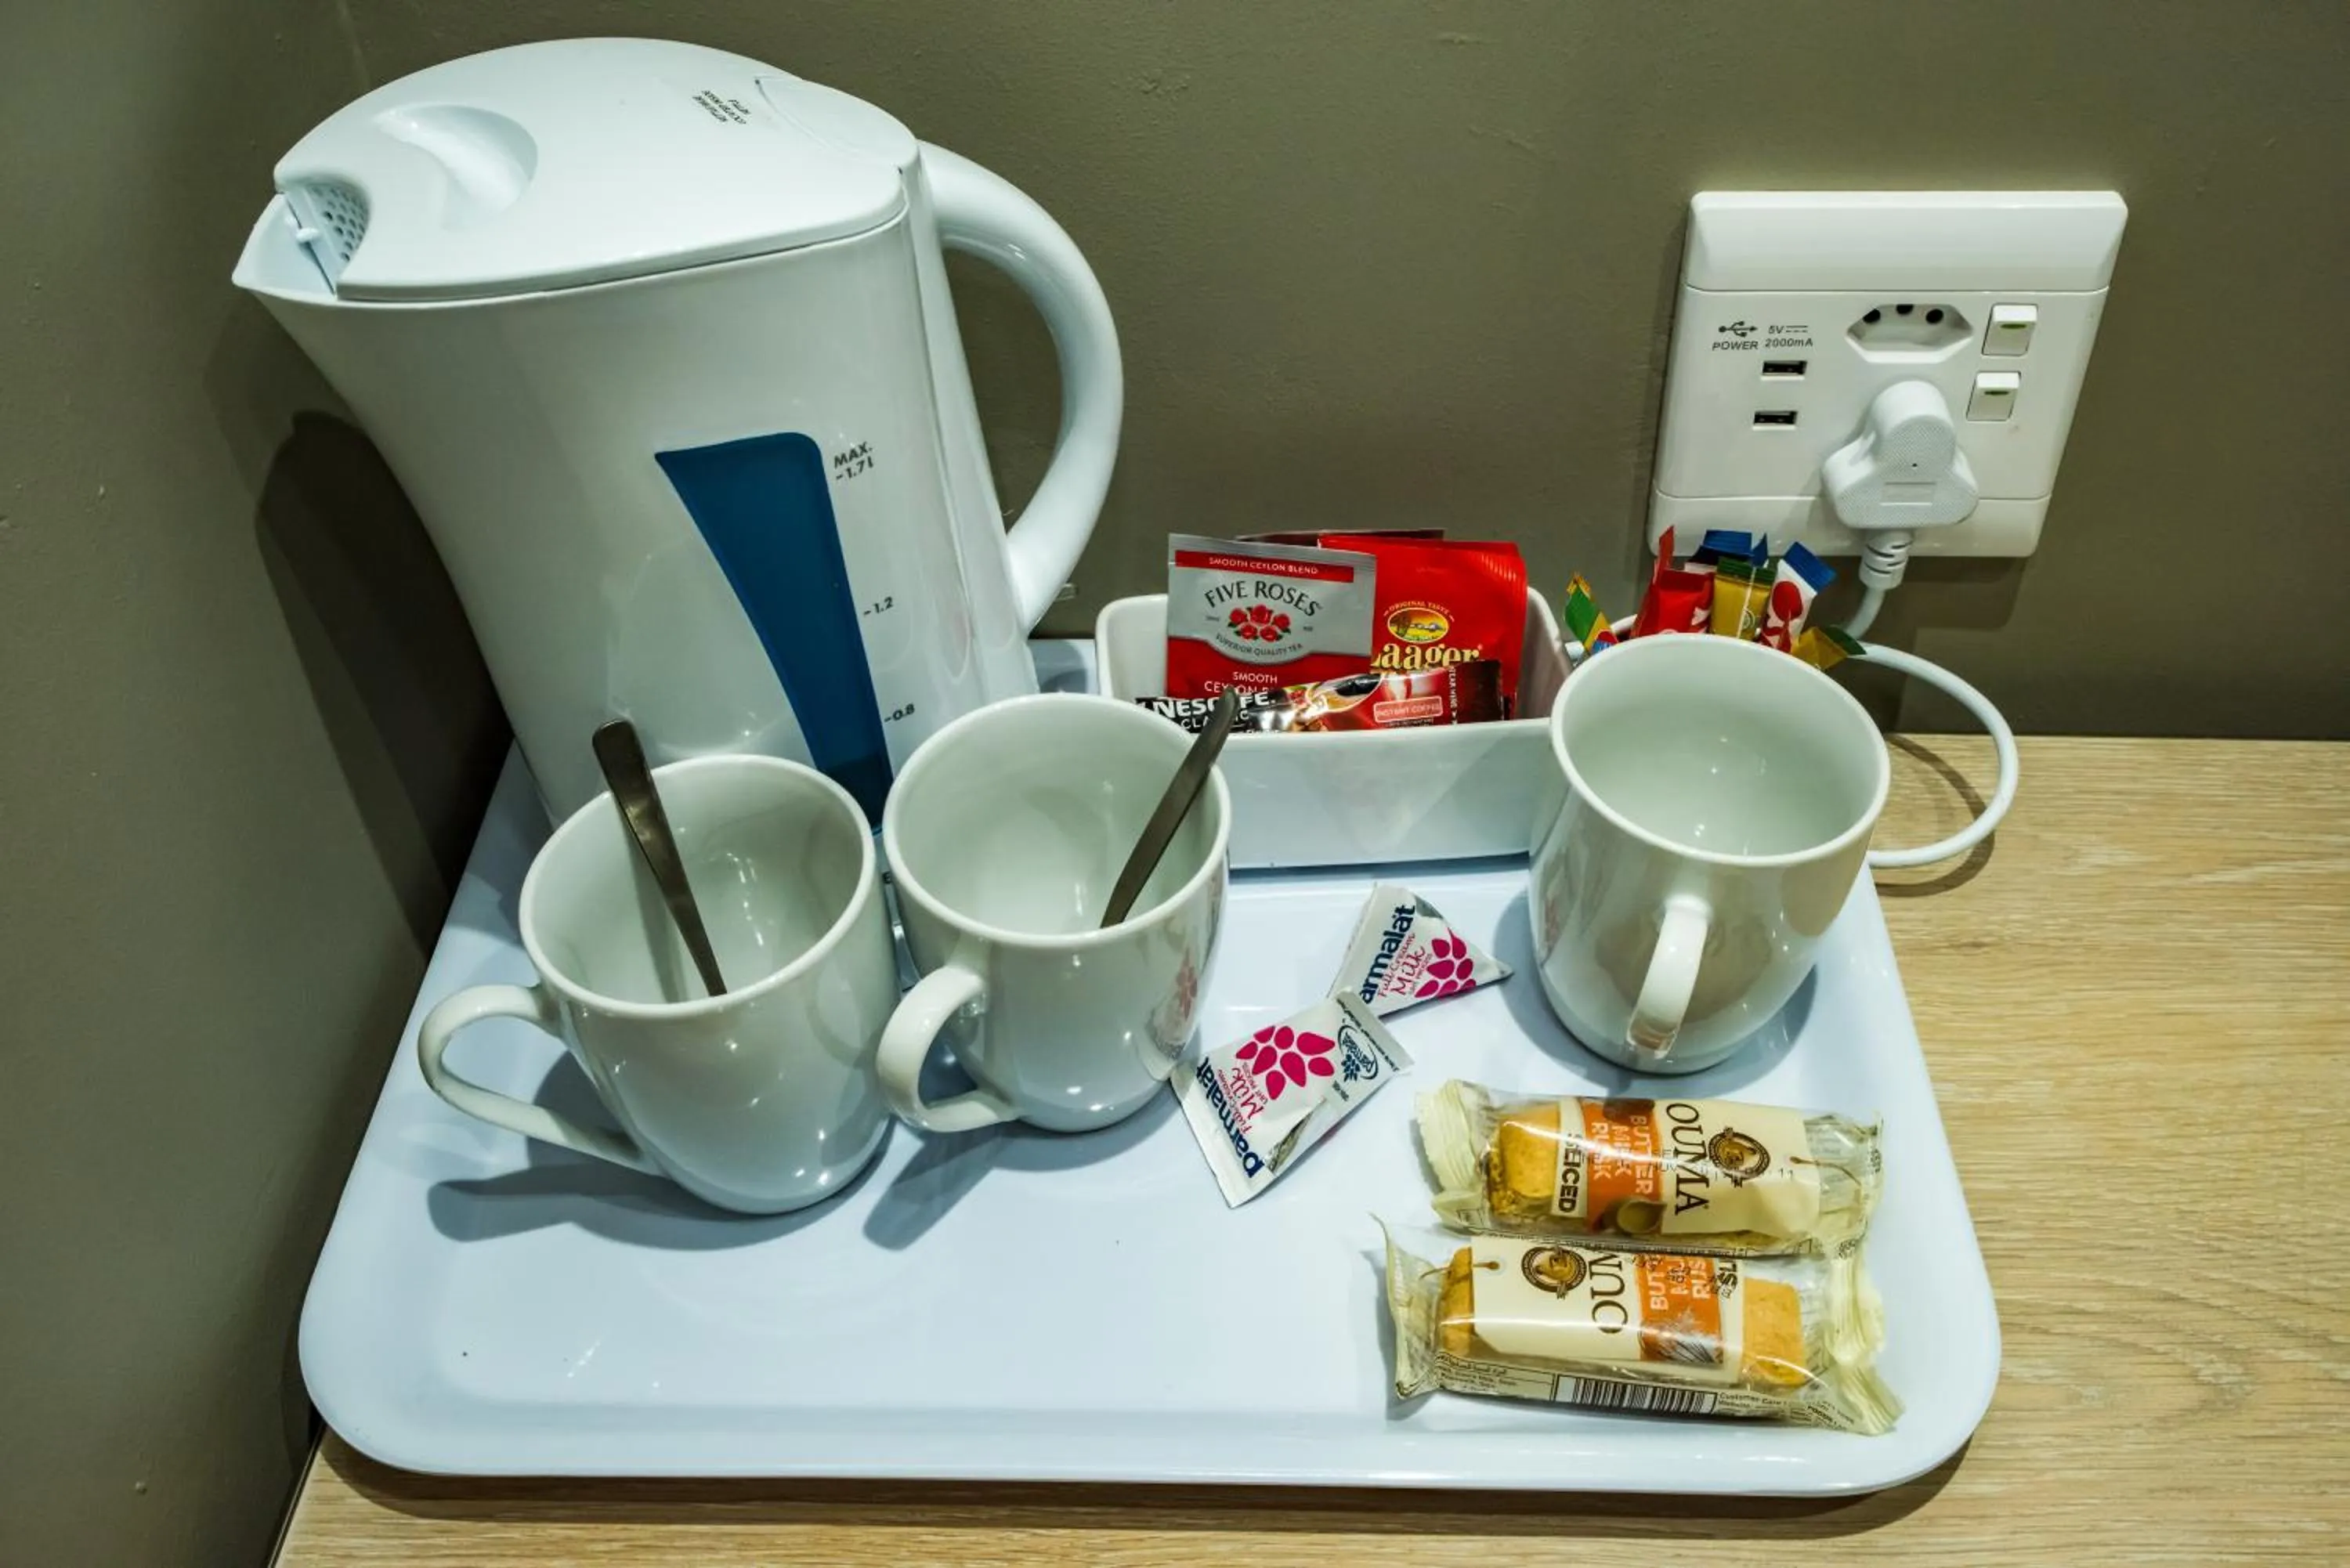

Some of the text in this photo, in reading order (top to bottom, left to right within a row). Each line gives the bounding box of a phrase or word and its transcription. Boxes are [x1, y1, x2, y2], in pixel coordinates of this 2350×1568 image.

[1768, 325, 1785, 334] 5V
[1712, 338, 1814, 352] POWER 2000mA
[1209, 557, 1318, 575] SMOOTH CEYLON BLEND
[1204, 580, 1320, 617] FIVE ROSES
[1216, 633, 1303, 656] SUPERIOR QUALITY TEA
[1205, 681, 1258, 694] CEYON
[1232, 671, 1278, 684] SMOOTH
[1360, 904, 1415, 1004] armalat
[1378, 973, 1393, 997] Full
[1390, 945, 1426, 995] Milk
[1231, 1067, 1265, 1120] Milk
[1196, 1056, 1265, 1178] parmalat
[1234, 1110, 1253, 1133] Full
[1629, 1115, 1654, 1195] BUTTER
[1666, 1102, 1709, 1216] OUMA
[1688, 1258, 1712, 1299] RUS
[1589, 1254, 1629, 1334] OUM
[1719, 1392, 1760, 1402] Customer
